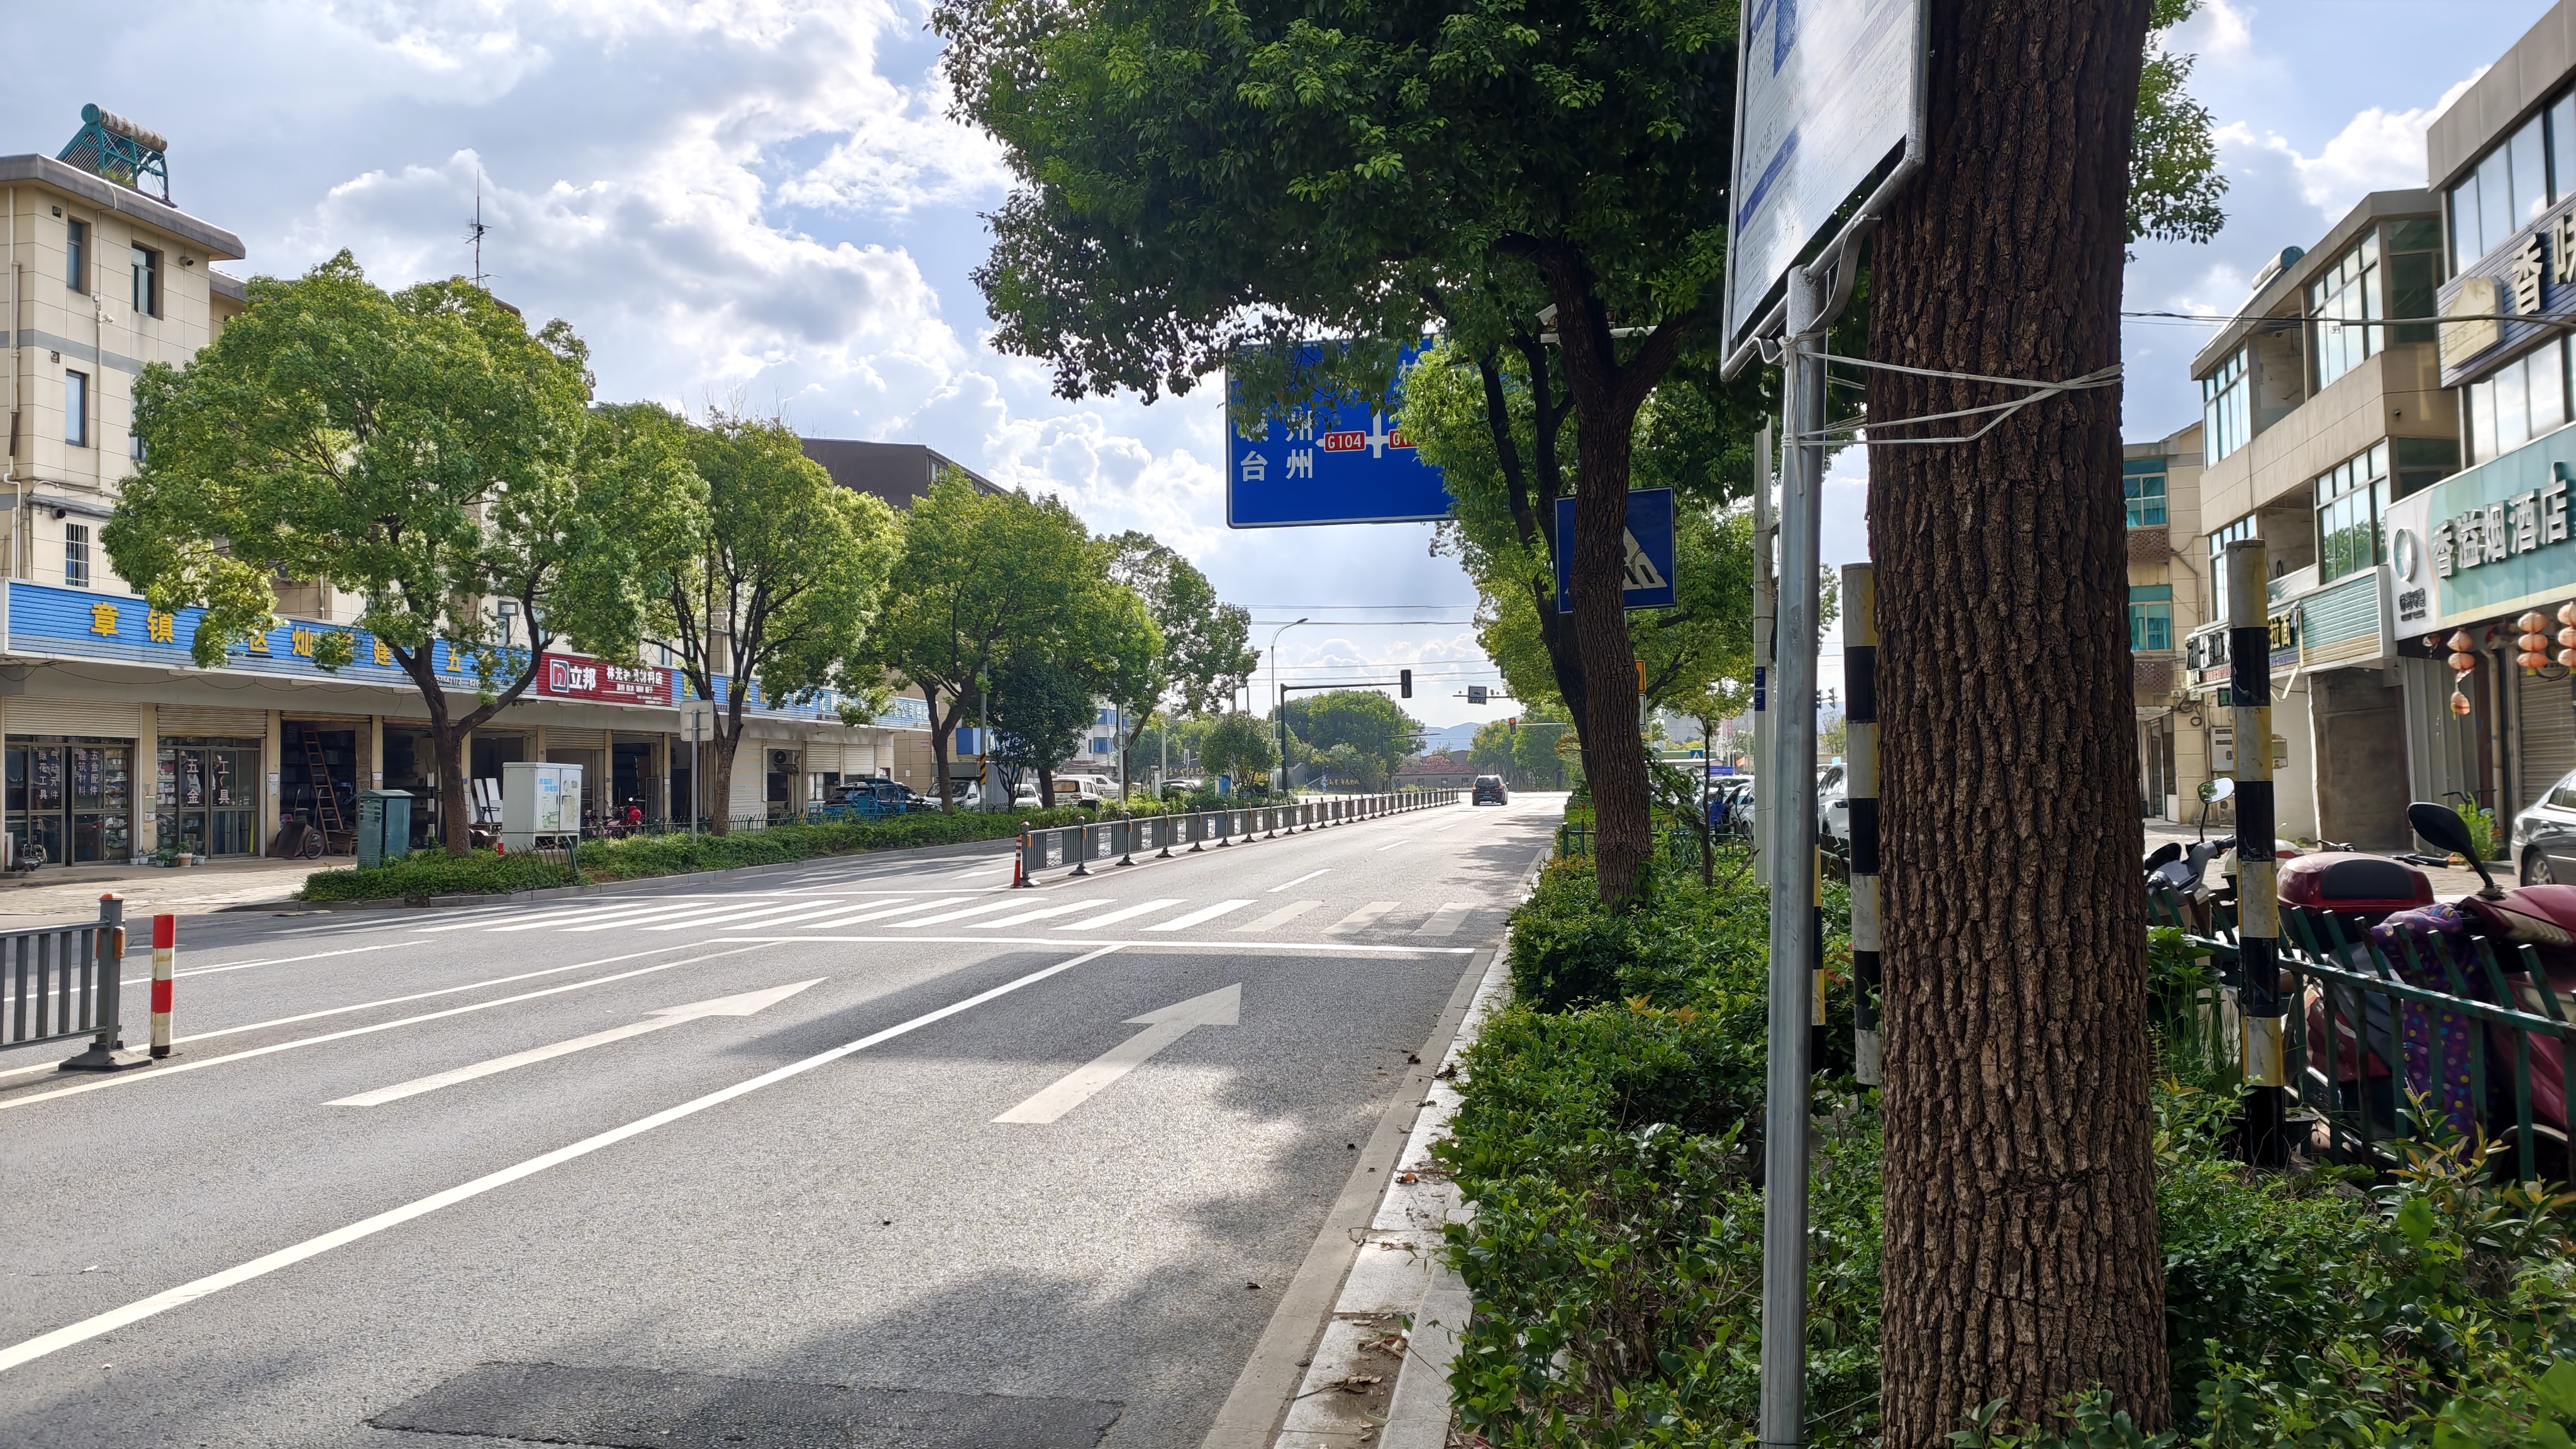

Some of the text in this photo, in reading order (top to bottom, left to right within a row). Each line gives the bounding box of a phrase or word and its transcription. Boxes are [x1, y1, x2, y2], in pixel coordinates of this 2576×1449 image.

[1240, 448, 1313, 482] 台州
[1328, 435, 1362, 449] G104
[2432, 460, 2568, 579] 香溢烟酒店
[569, 665, 596, 691] 立邦
[50, 750, 60, 800] 气动元件
[77, 748, 87, 796] 建筑材料
[89, 750, 99, 796] 五金配件
[186, 758, 199, 804] 五金
[218, 760, 230, 804] 工具
